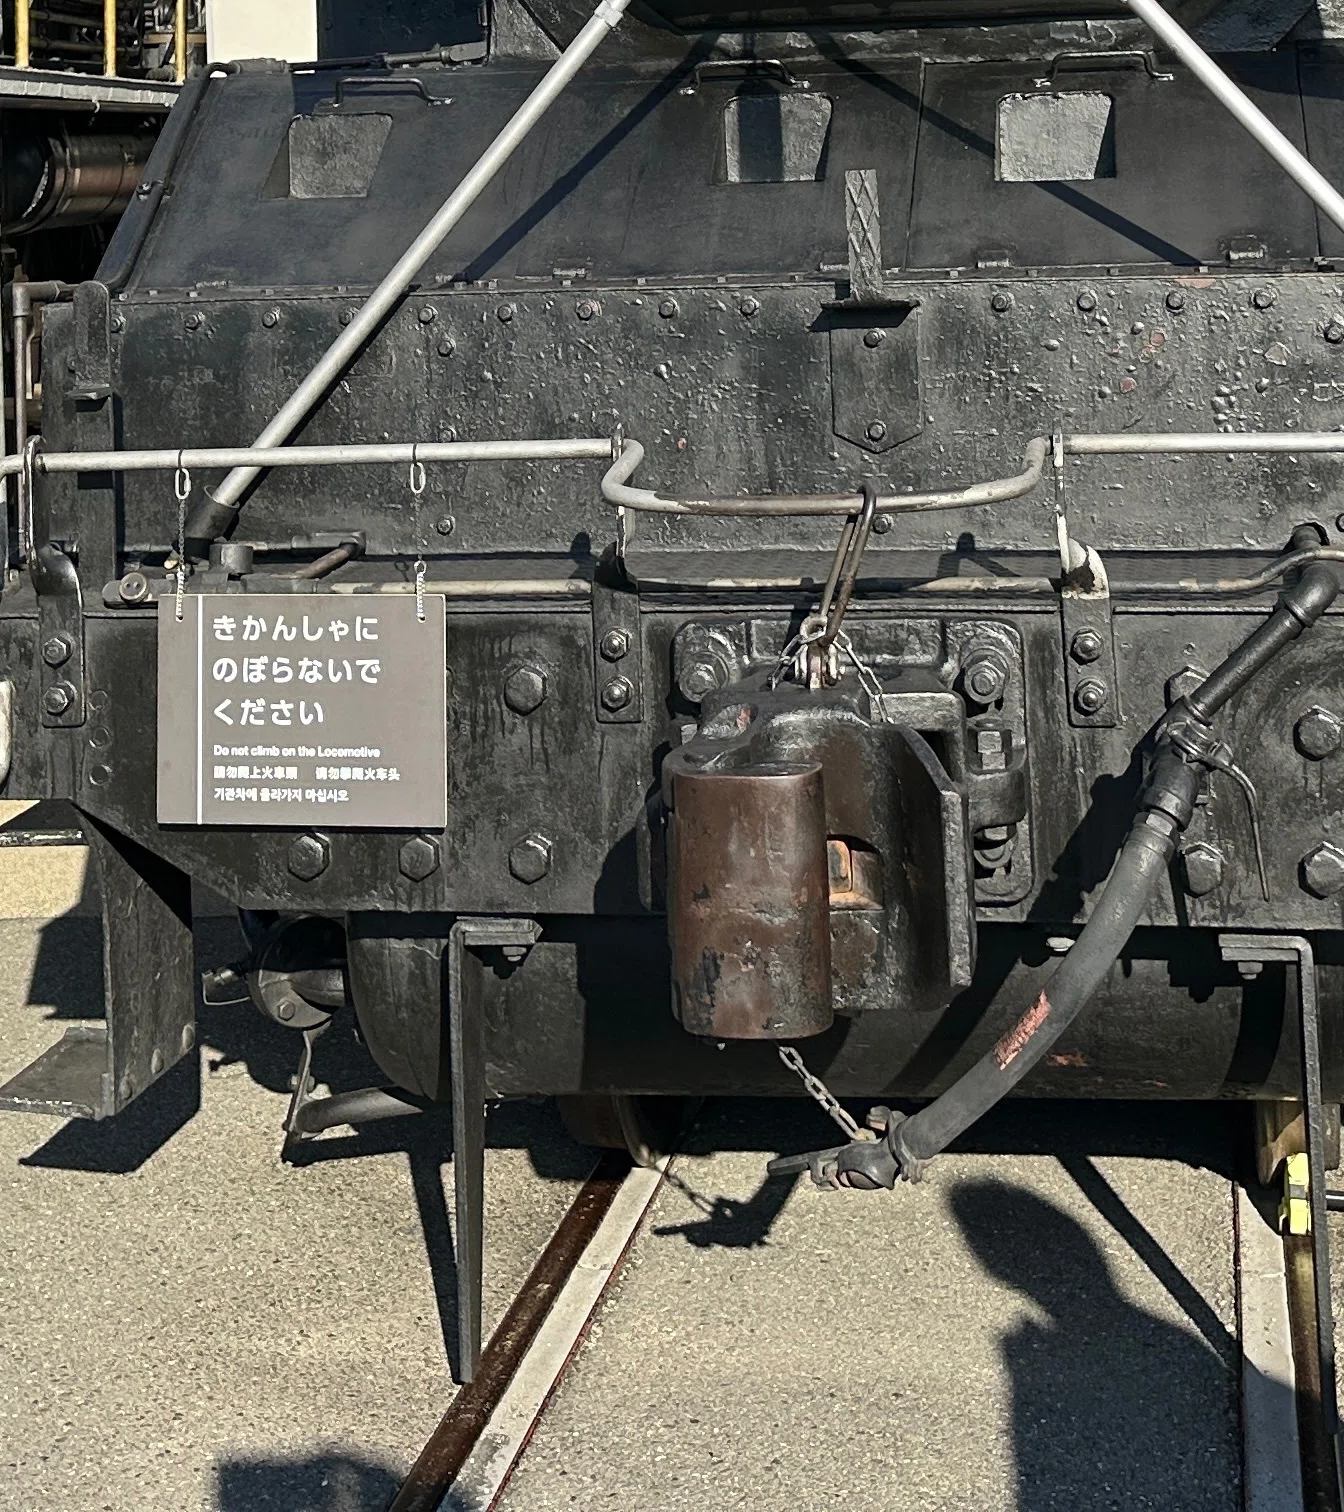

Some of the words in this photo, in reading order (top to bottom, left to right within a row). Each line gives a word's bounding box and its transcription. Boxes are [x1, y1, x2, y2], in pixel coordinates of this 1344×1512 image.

[212, 615, 379, 642] きかんしゃに
[212, 656, 382, 684] のぼらないで
[213, 698, 324, 726] ください
[213, 744, 229, 756] Do
[231, 745, 249, 756] not
[250, 745, 280, 757] climb
[281, 747, 296, 757] on
[297, 745, 316, 757] the
[317, 745, 381, 758] Locomotive
